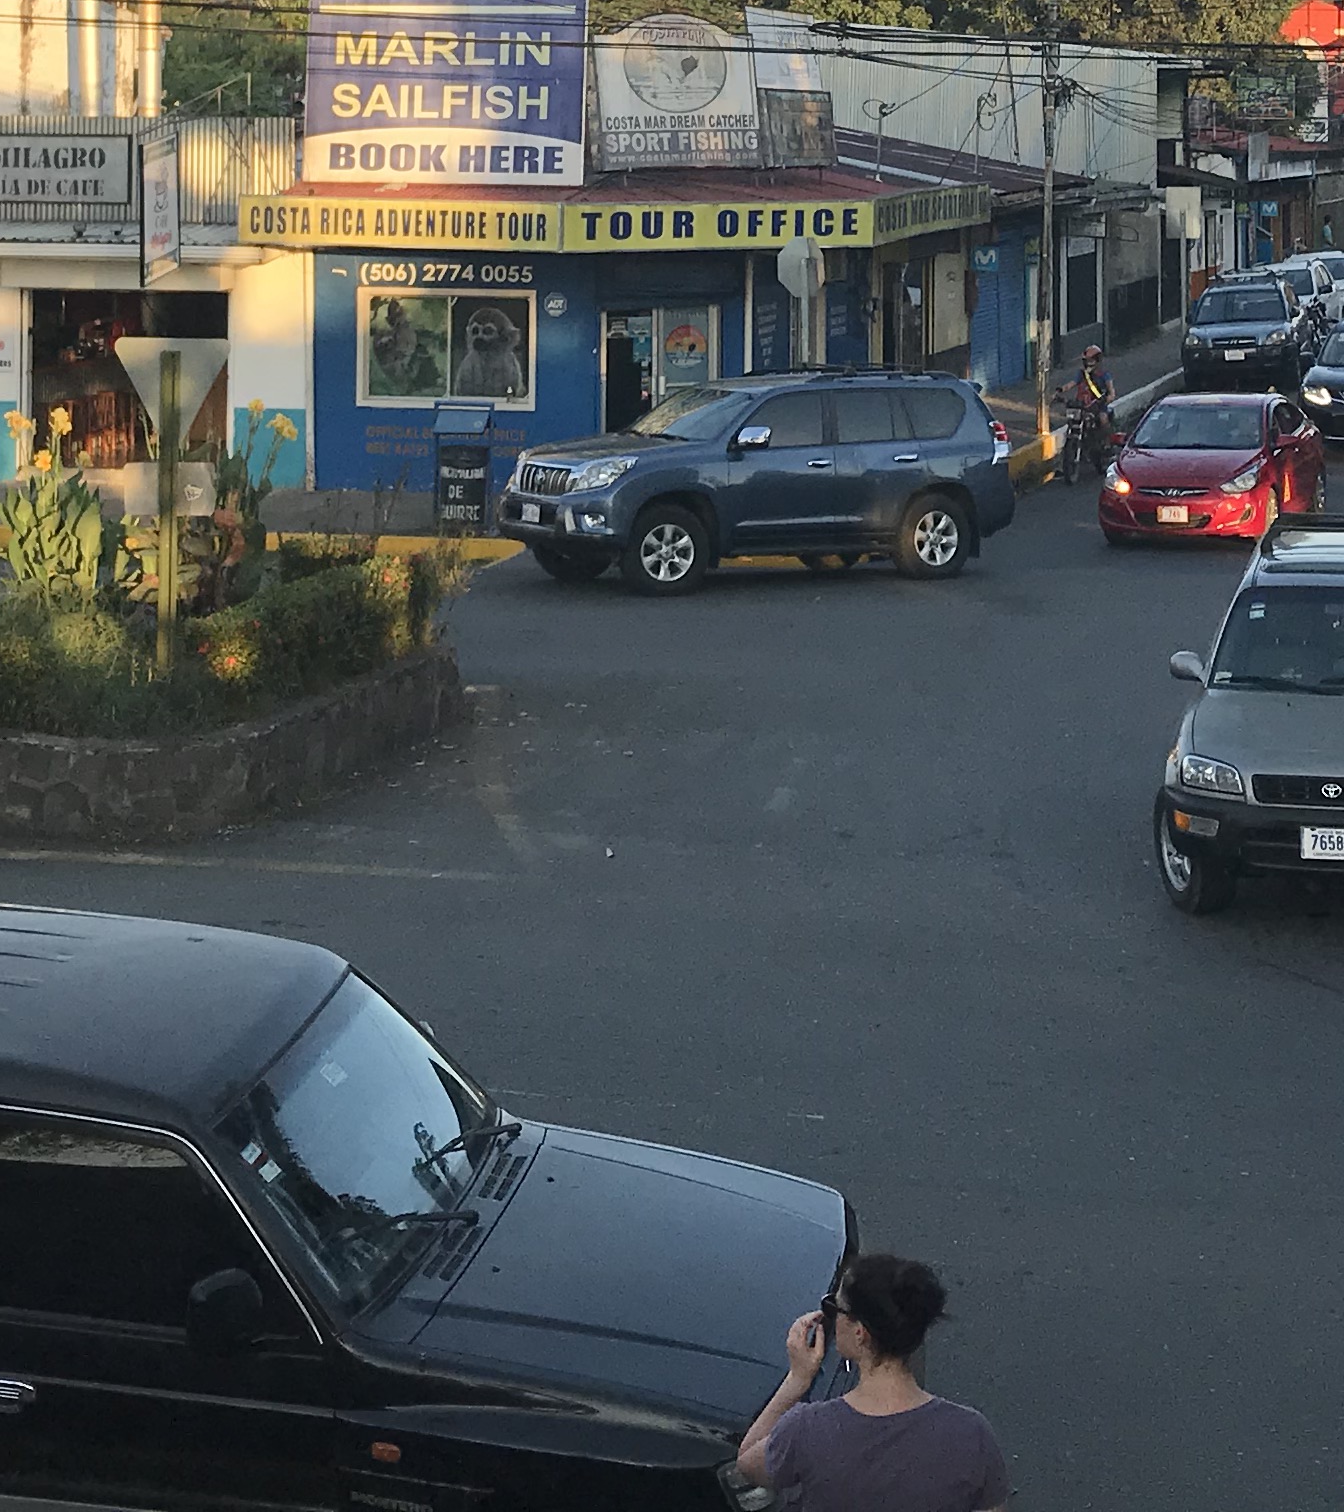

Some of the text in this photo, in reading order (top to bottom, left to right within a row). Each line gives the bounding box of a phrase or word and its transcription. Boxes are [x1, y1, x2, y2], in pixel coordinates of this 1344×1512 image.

[334, 30, 551, 66] MARLIN
[331, 82, 549, 120] SAILFISH
[606, 113, 756, 130] COSTA MAR DREAM CATCHER
[606, 130, 759, 154] SPORT FISHING
[329, 142, 564, 174] BOOK HERE
[26, 179, 51, 196] DE
[56, 179, 105, 197] CAFE
[250, 205, 547, 242] COSTA RICA ADVENTURE TOUR
[581, 208, 859, 240] TOUR OFFICE
[360, 262, 533, 286] (506) 2774 0055
[448, 485, 464, 499] DE
